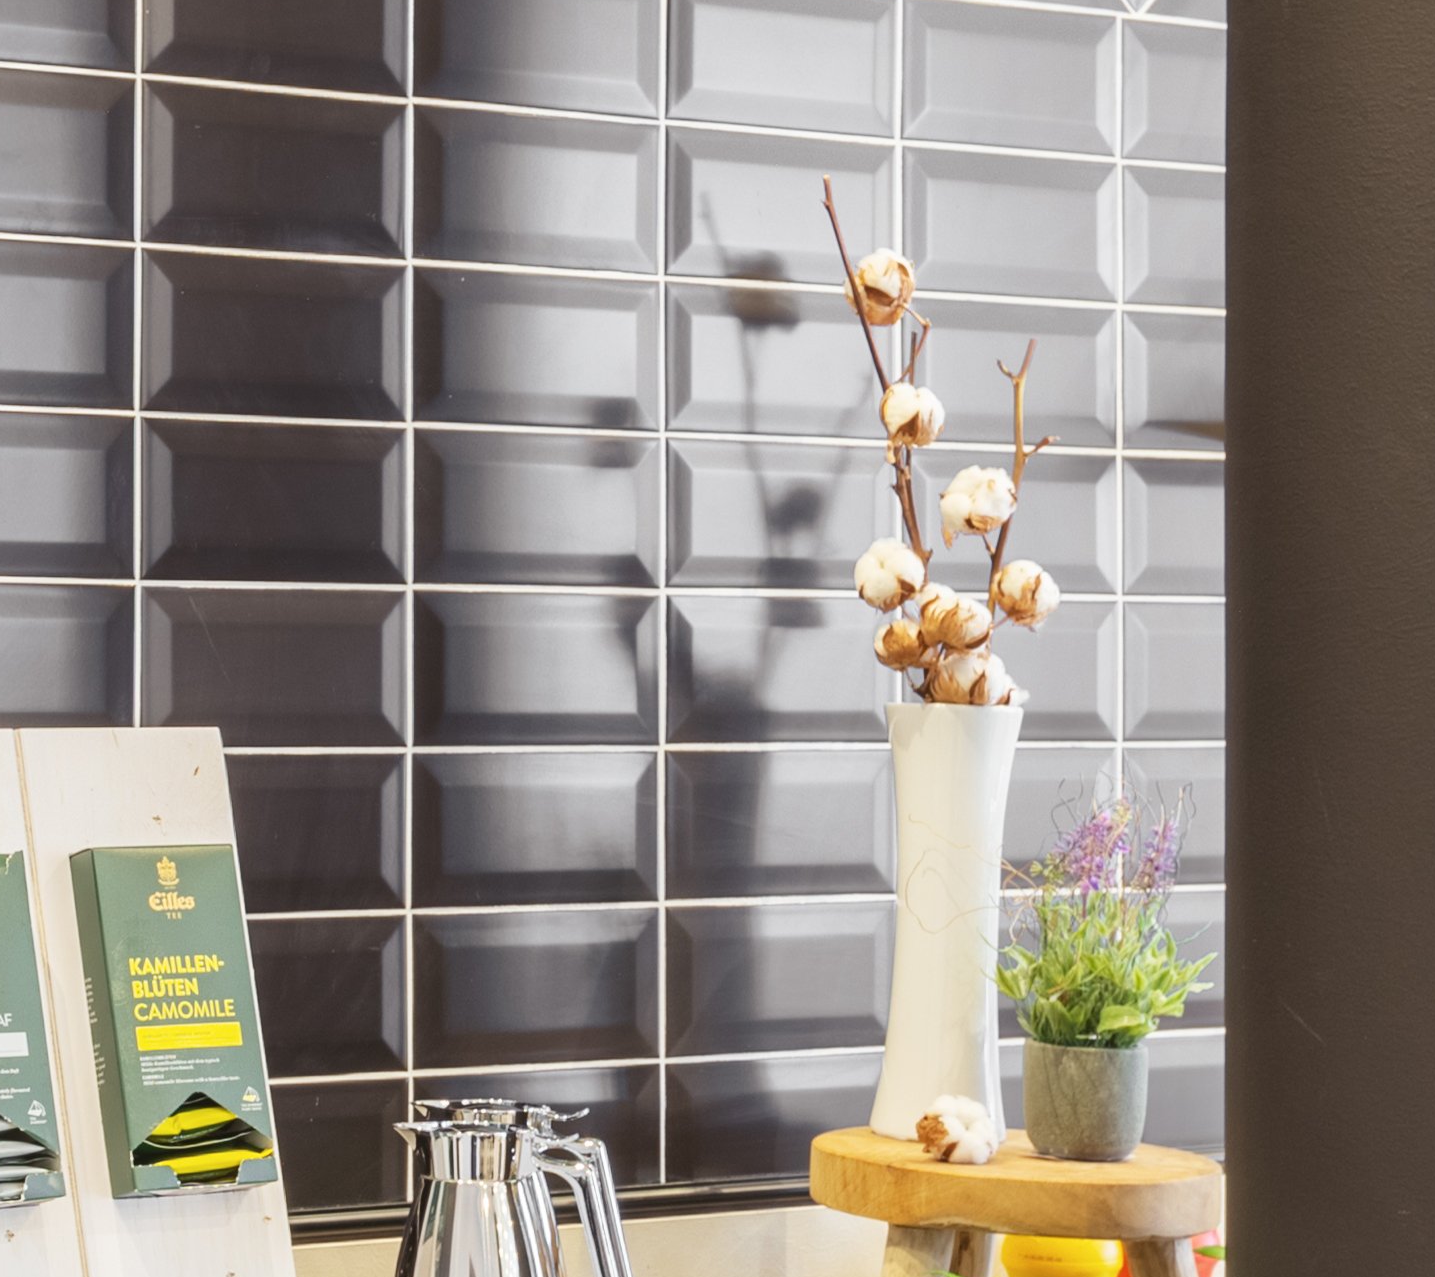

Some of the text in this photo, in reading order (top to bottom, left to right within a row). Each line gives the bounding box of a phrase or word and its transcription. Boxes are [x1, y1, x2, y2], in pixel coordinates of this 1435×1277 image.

[148, 891, 196, 912] Eilles
[166, 912, 183, 920] TEE
[128, 954, 225, 976] KAMILLEN-
[131, 975, 199, 999] BLÜTEN
[133, 999, 236, 1022] CAMOMILE
